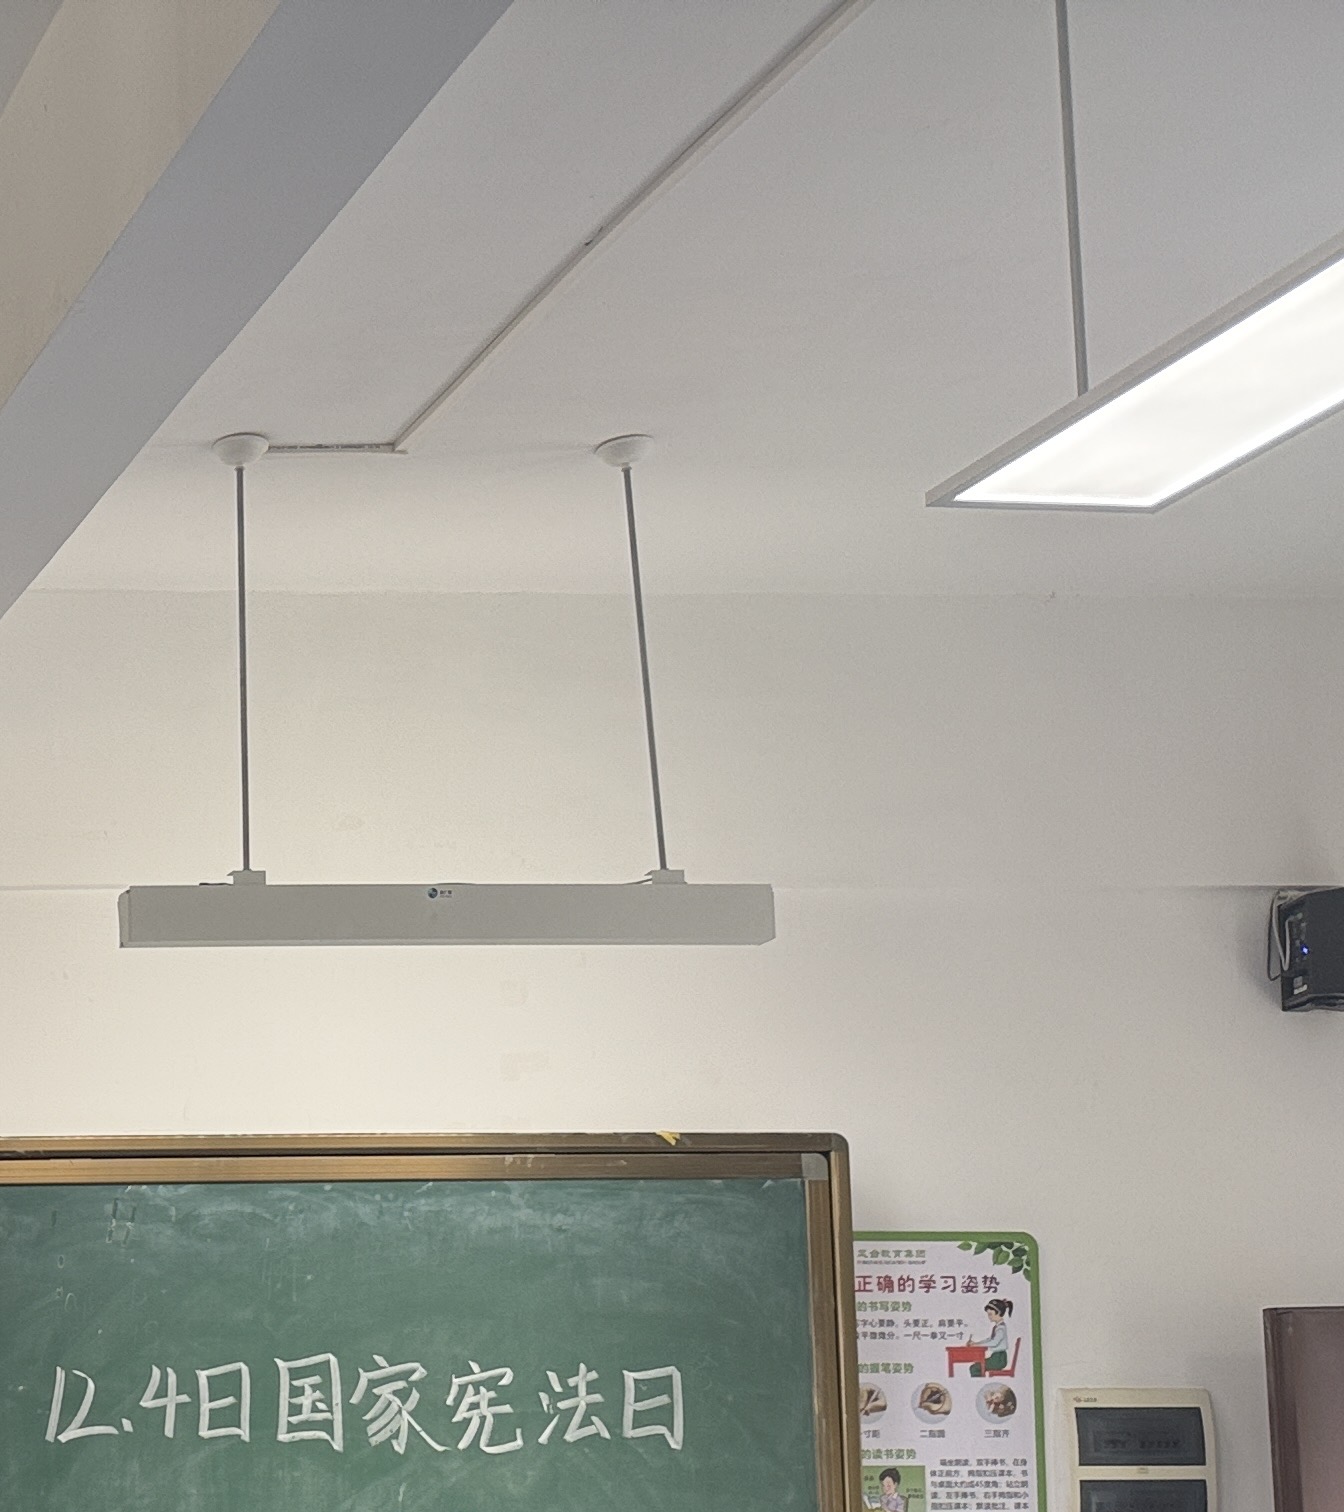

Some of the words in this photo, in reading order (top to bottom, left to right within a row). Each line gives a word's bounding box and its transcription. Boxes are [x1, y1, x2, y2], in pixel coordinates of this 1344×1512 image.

[855, 1274, 1000, 1294] 正确的学习姿势
[857, 1301, 912, 1313] 的书写姿势
[44, 1352, 686, 1455] 12.4日国家宪法日
